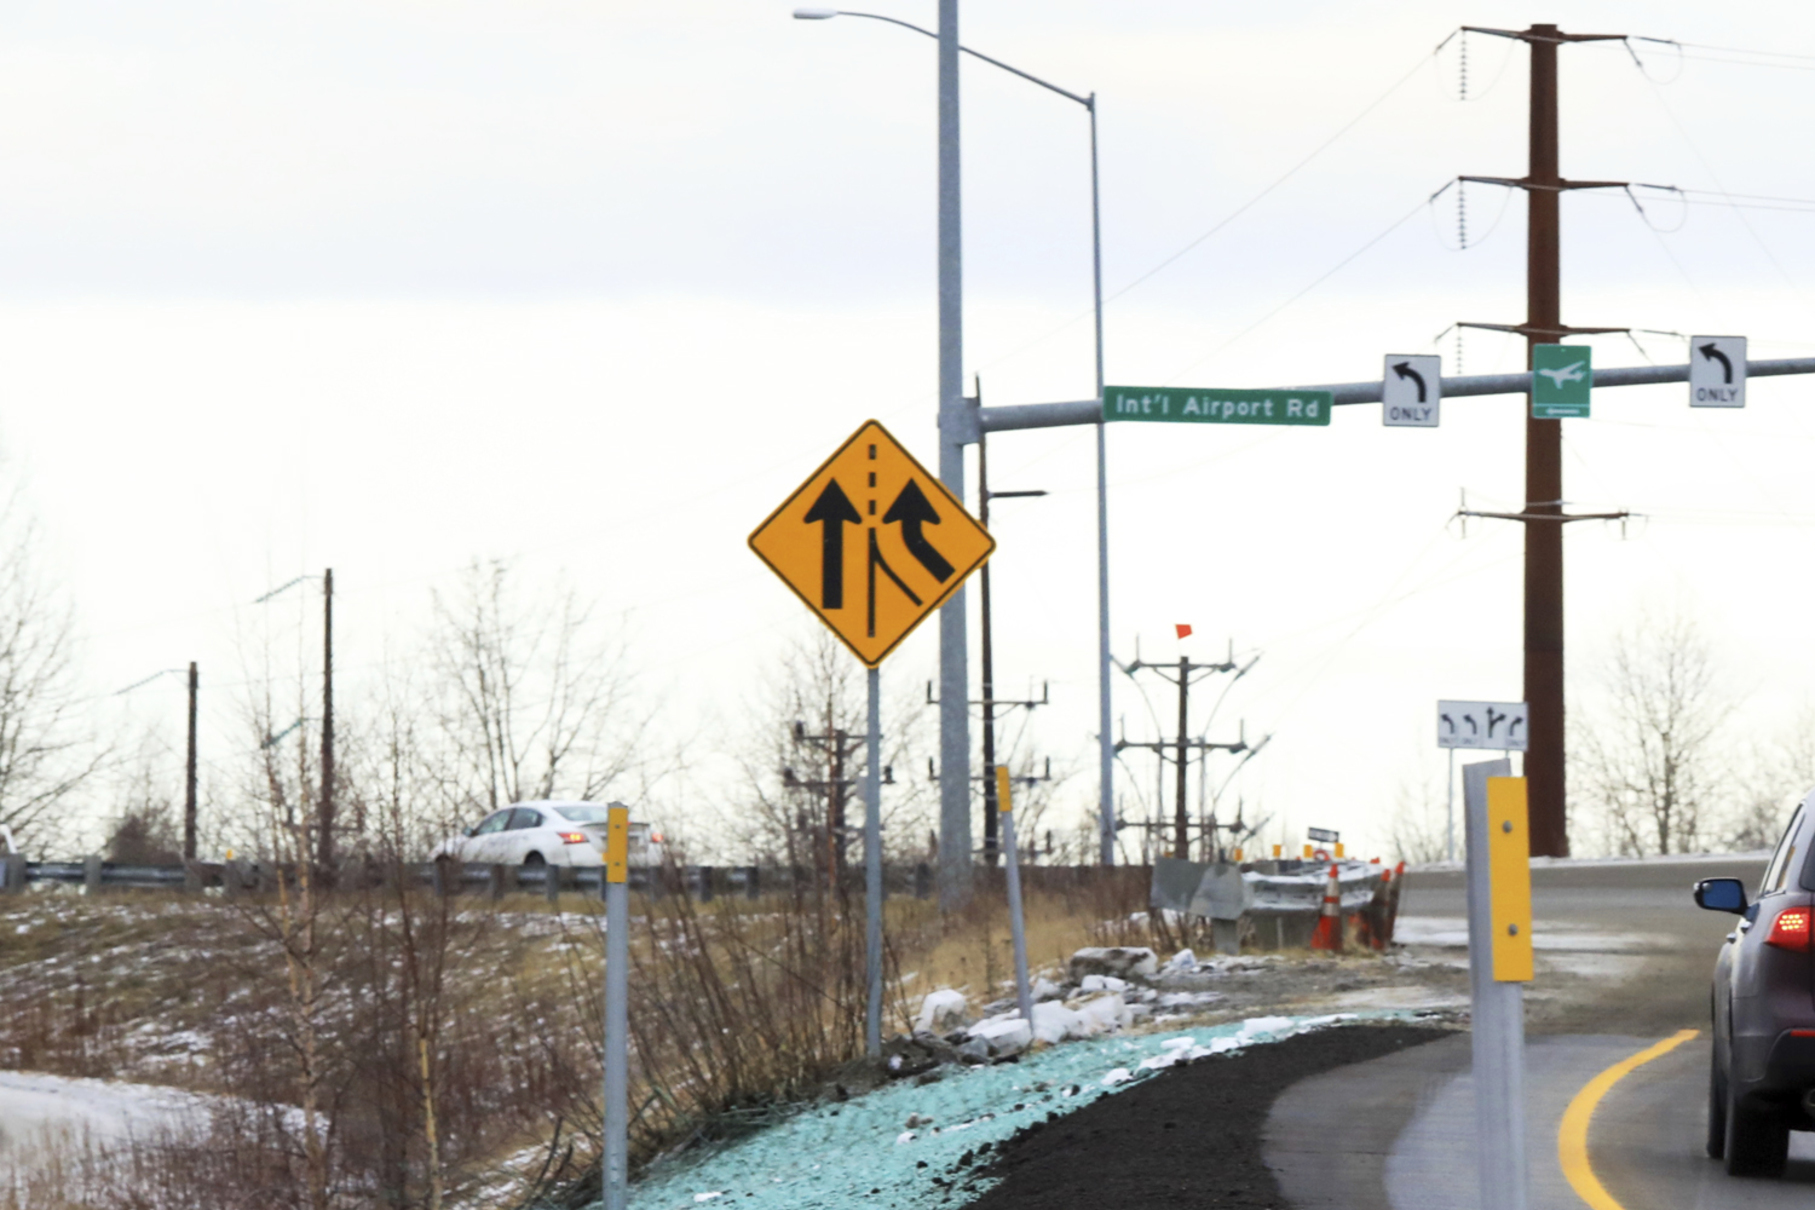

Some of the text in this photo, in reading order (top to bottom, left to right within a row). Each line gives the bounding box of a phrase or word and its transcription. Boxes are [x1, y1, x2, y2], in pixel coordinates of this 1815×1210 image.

[1697, 387, 1738, 402] ONLY
[1116, 394, 1319, 419] Int'l Airport Rd
[1390, 406, 1432, 420] ONLY
